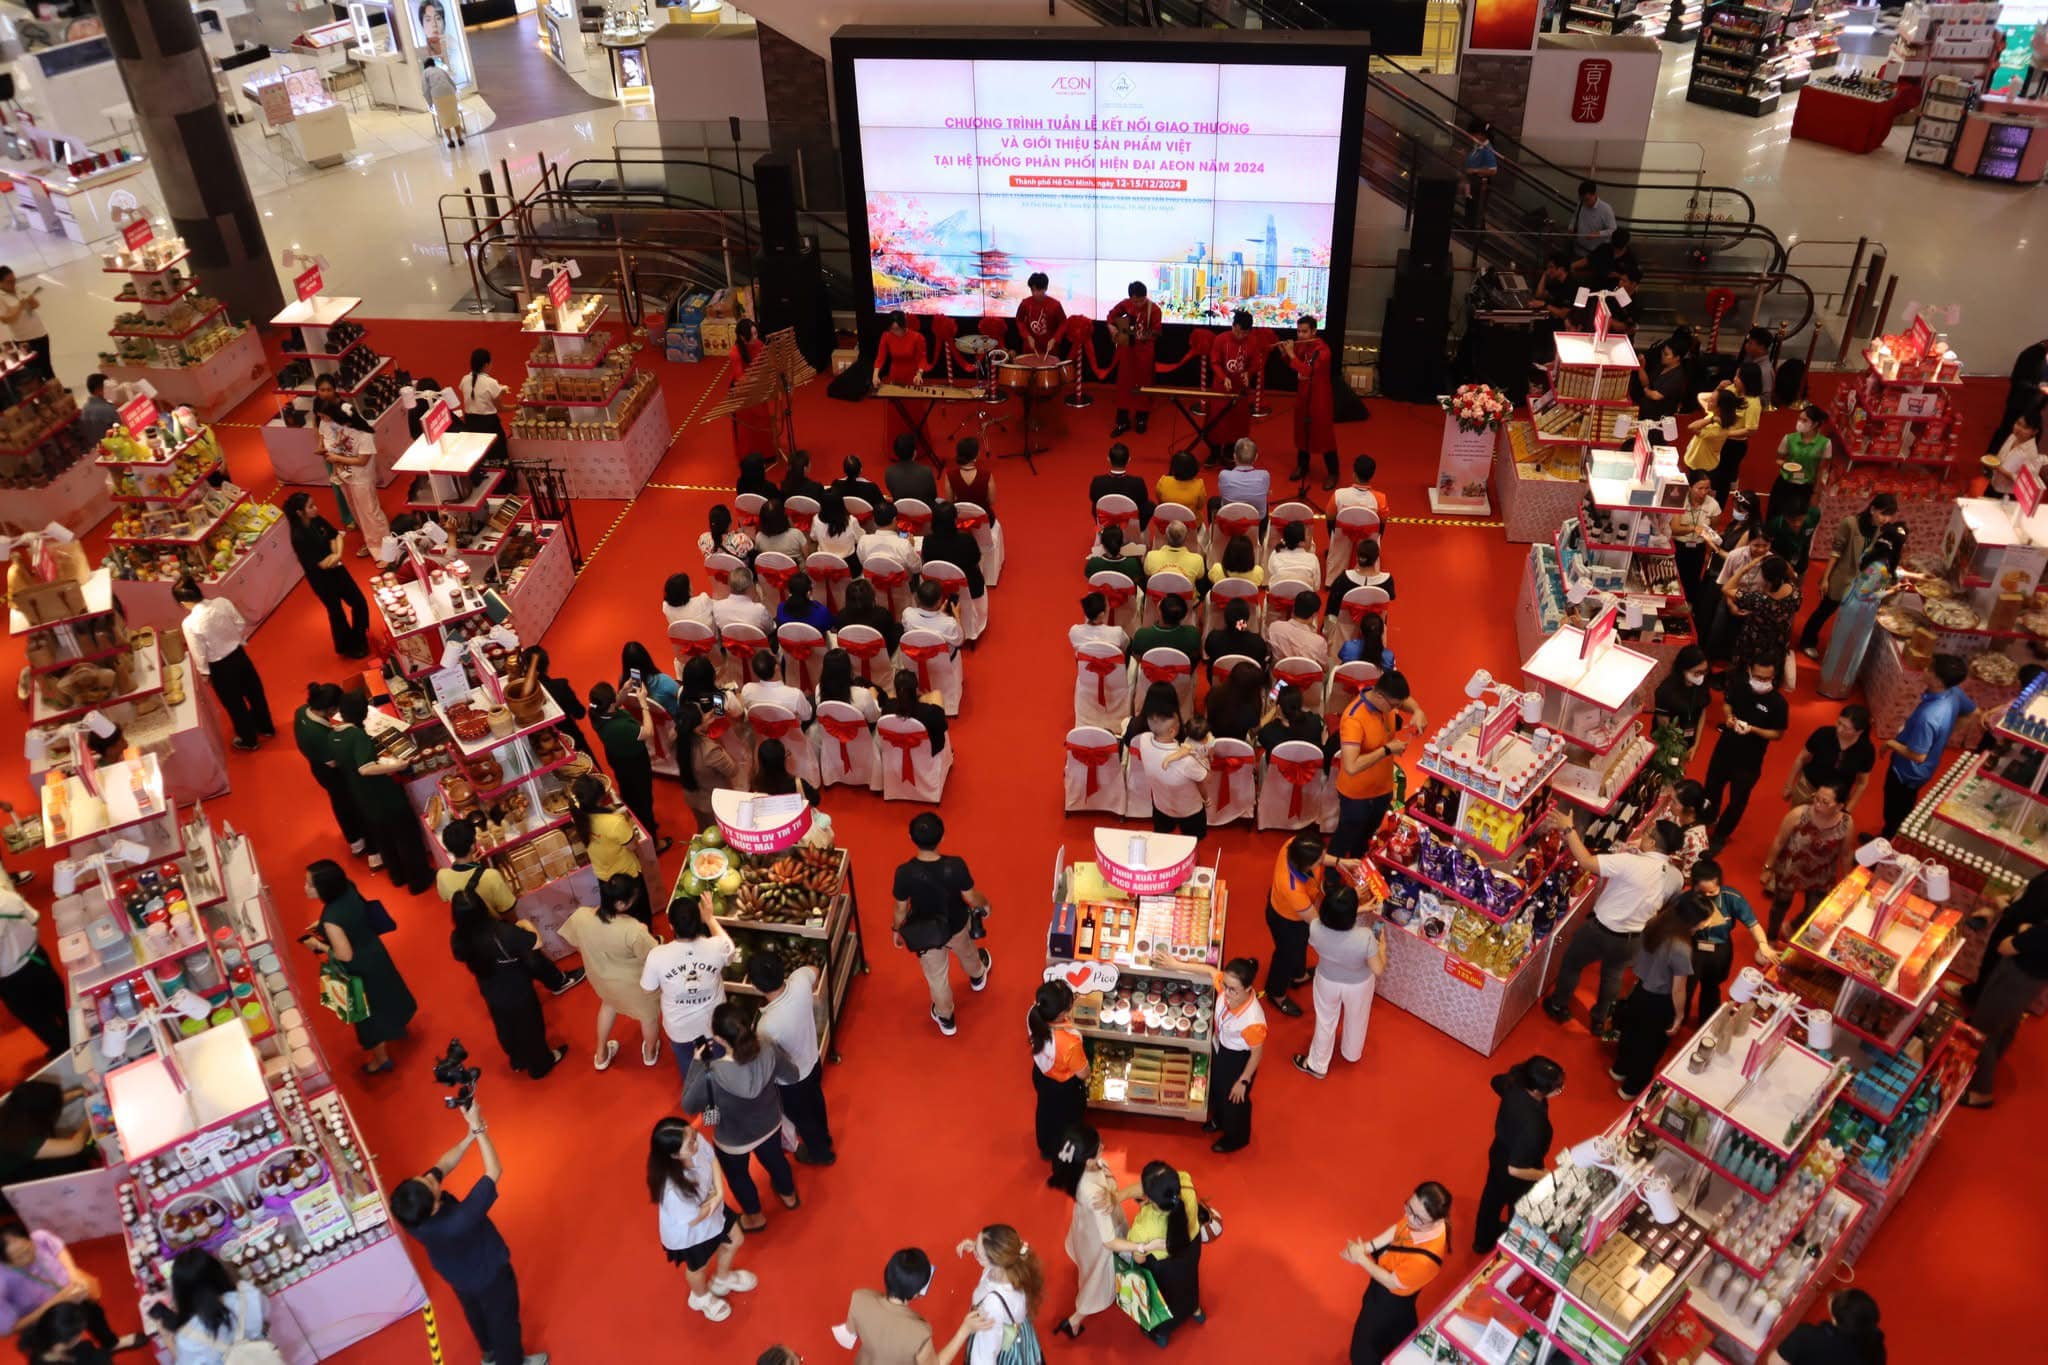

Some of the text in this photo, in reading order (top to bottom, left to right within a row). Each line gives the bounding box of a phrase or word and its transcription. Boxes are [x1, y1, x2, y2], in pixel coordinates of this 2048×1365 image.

[1579, 63, 1607, 120] 貢茶
[944, 114, 1250, 135] CHƯƠNG TRÌNH TUẦN LỄ KẾT NỐI GIAO THƯƠNG
[1001, 134, 1192, 155] VÀ GIỚI THIỆU SẢN PHẨM VIỆT
[934, 152, 1264, 173] TẠI HỆ THỐNG PHÂN PHỐI HIỆN ĐẠI AEON NĂM 2024
[1116, 179, 1181, 189] 12-15/12/2024
[762, 833, 774, 842] DV
[754, 842, 774, 851] MAI
[1112, 875, 1170, 891] PICO AGRIVIET
[1135, 870, 1157, 881] XUẤT
[665, 962, 718, 980] NEW YORK
[1093, 971, 1116, 984] Pico
